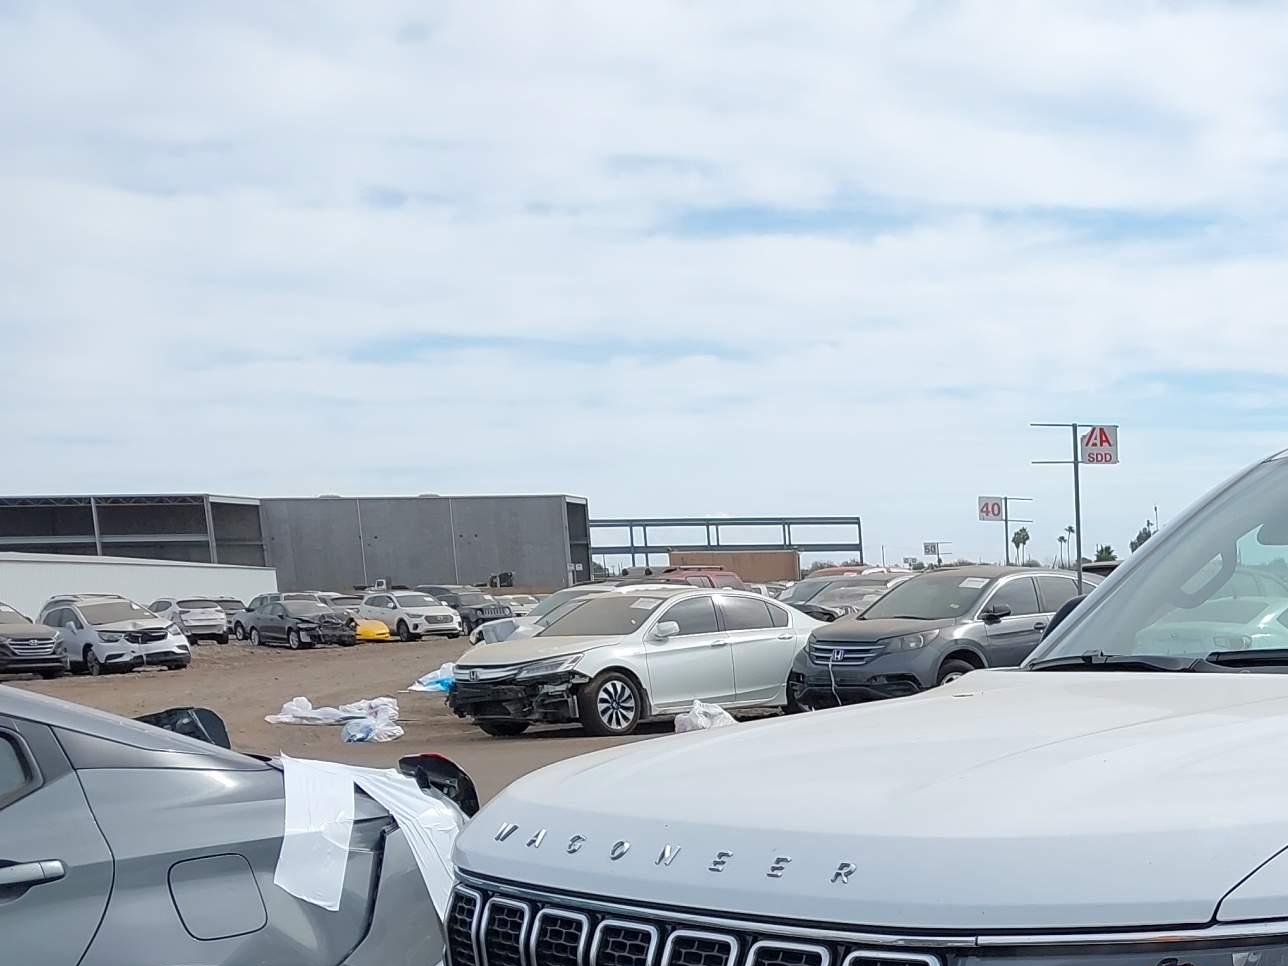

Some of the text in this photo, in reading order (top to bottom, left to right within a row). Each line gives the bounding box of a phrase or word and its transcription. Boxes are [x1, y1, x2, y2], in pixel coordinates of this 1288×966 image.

[1087, 452, 1112, 463] SDD
[980, 502, 1001, 517] 40
[924, 544, 936, 553] 50
[494, 822, 857, 884] WAGONEER
